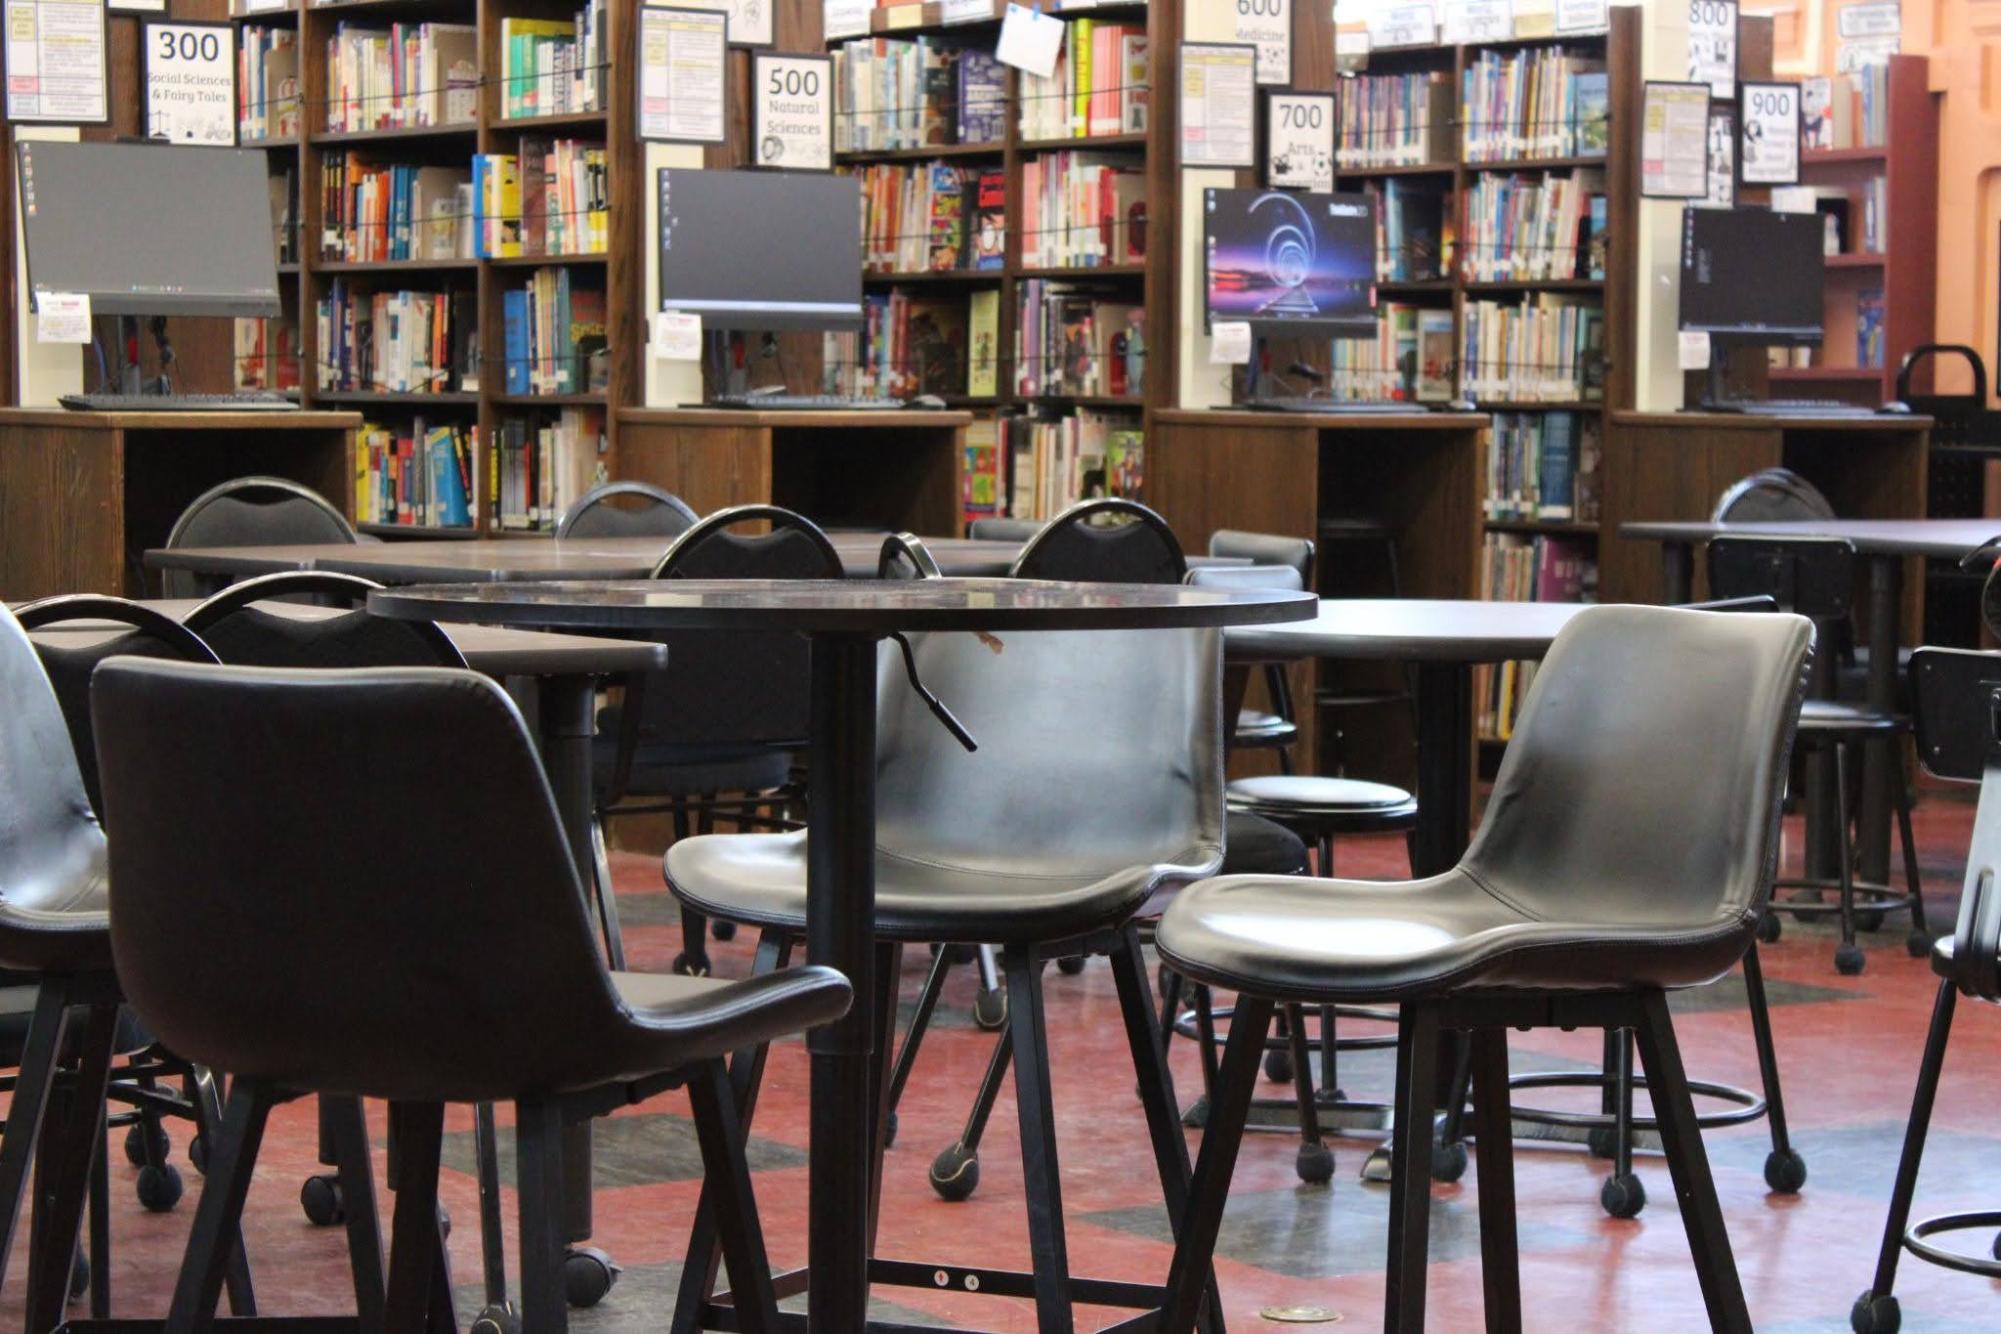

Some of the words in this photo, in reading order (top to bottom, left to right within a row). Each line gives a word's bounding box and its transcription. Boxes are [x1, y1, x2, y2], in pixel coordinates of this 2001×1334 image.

[1237, 0, 1281, 16] 600
[1689, 0, 1728, 26] 800
[159, 31, 219, 62] 300
[149, 72, 181, 85] Social
[183, 73, 231, 87] Sciences
[769, 66, 819, 97] 500
[152, 89, 161, 100] &
[164, 88, 195, 105] Fairy
[197, 90, 227, 103] Tales
[1752, 92, 1790, 117] 900
[769, 100, 820, 115] Natural
[1279, 104, 1322, 129] 700
[766, 119, 821, 136] Sciences
